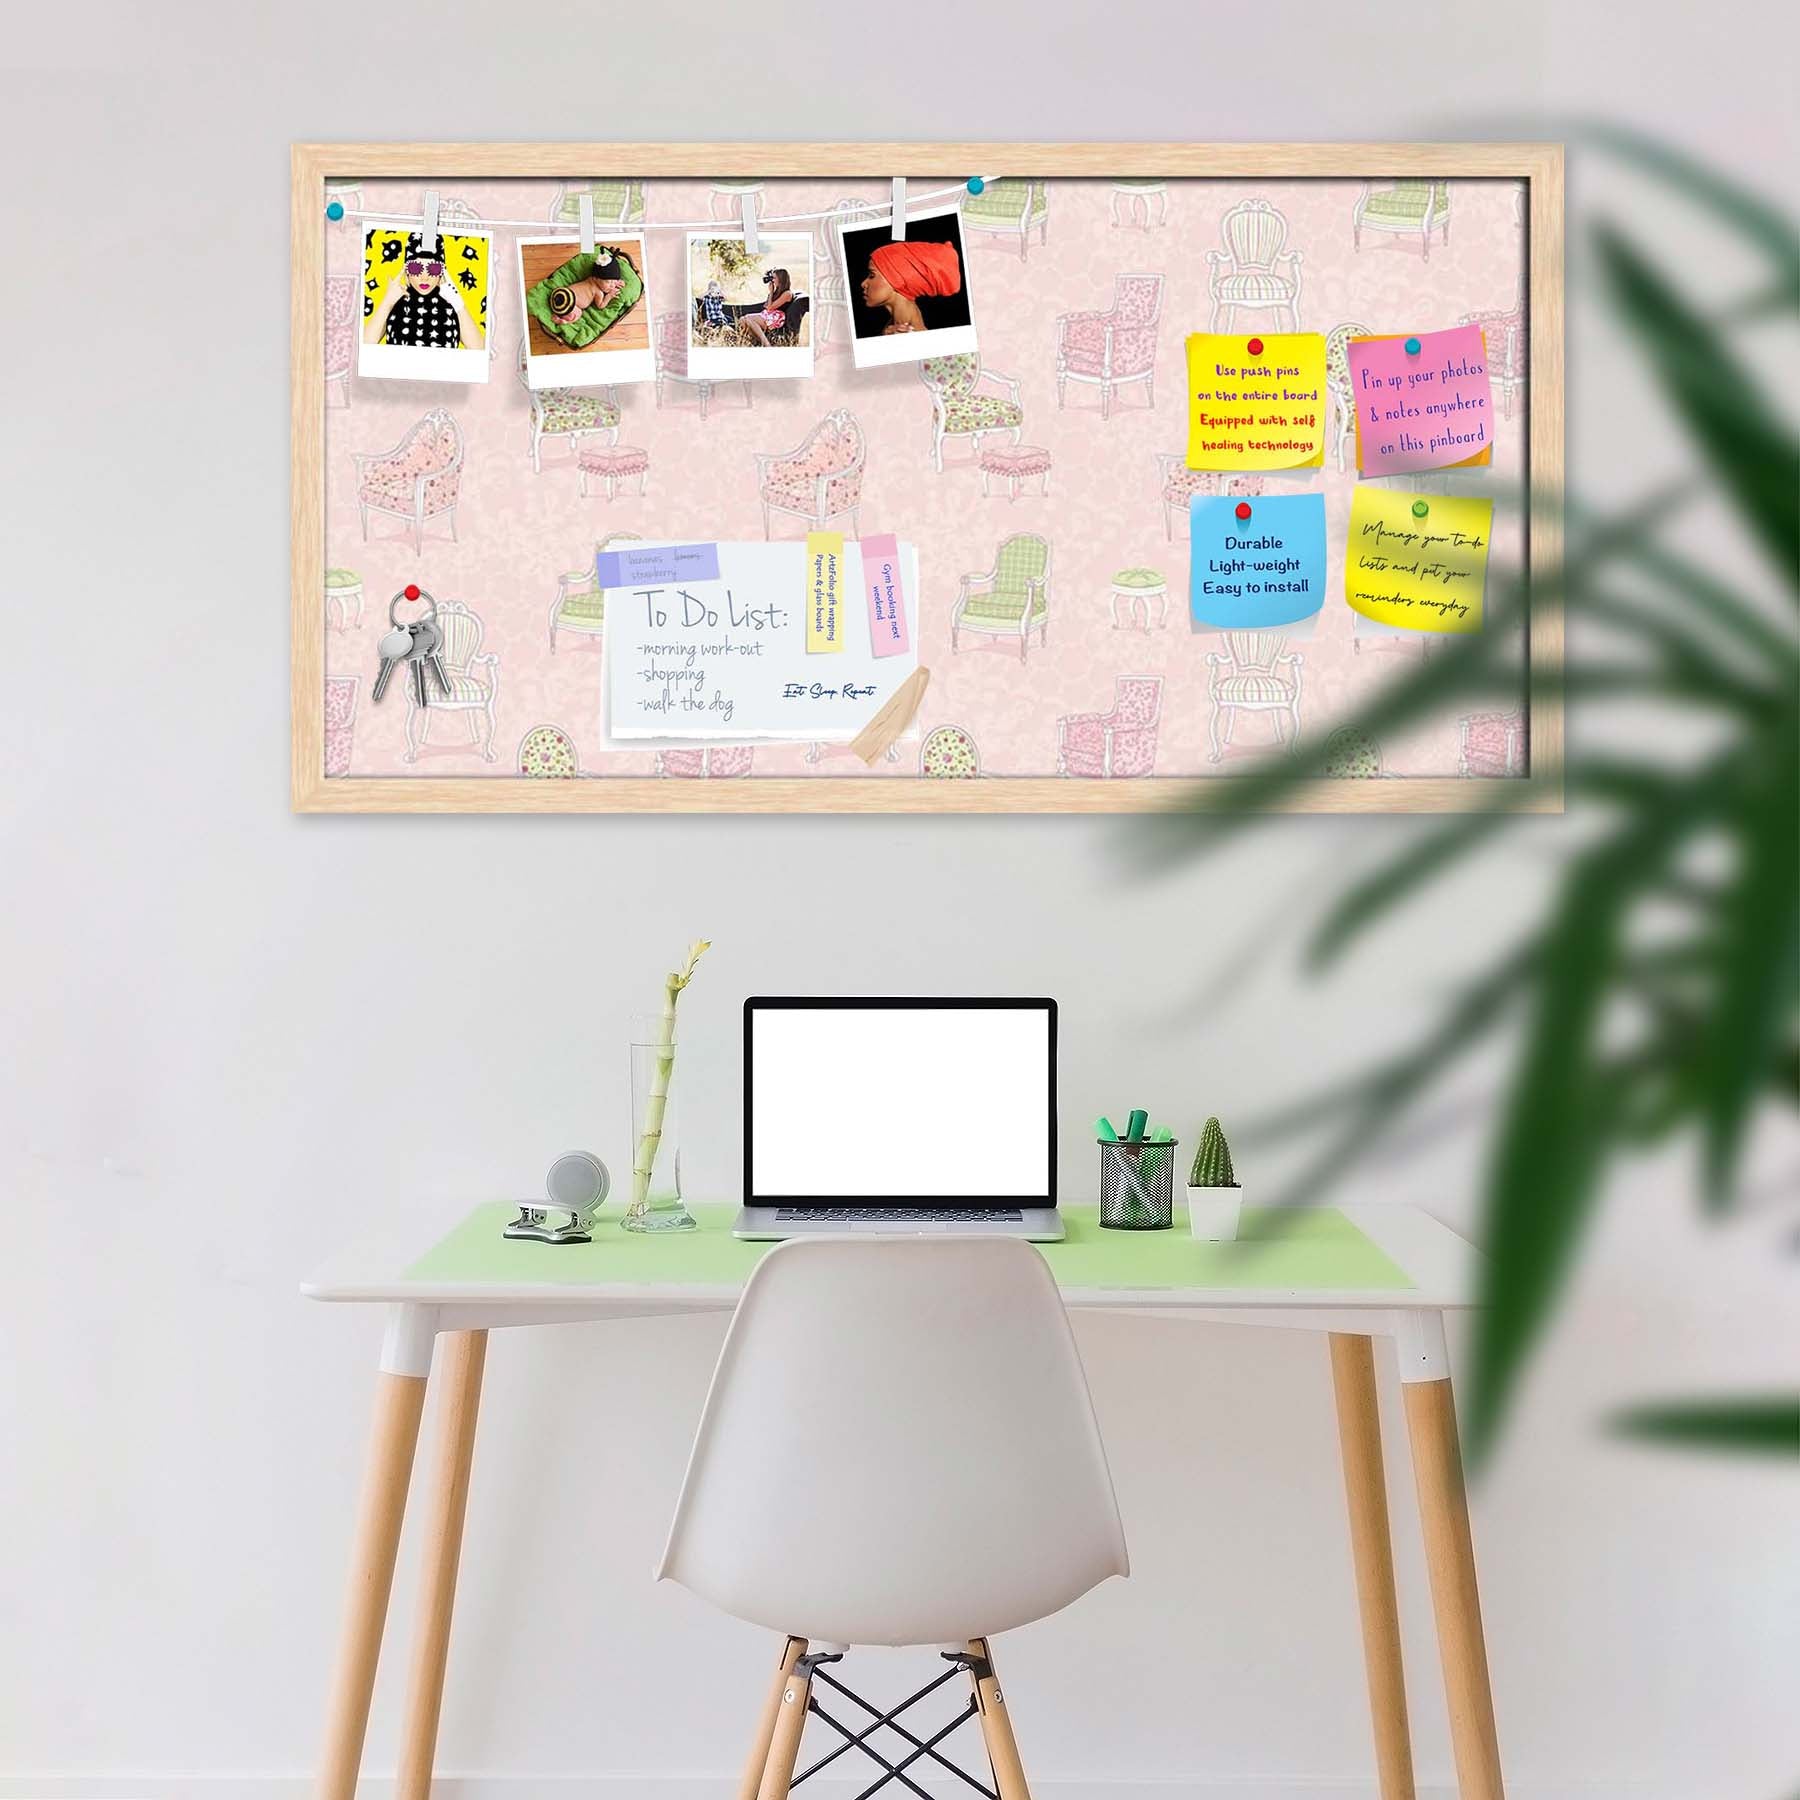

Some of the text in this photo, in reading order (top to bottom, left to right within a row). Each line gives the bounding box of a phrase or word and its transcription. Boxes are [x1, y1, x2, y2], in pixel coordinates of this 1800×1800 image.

[1216, 364, 1299, 380] Use push pins
[1362, 358, 1483, 390] Pin up your photos
[1198, 389, 1318, 401] on the entire board
[1370, 392, 1485, 422] & notes anywhere
[1200, 413, 1315, 429] Equipped with self
[1202, 440, 1313, 452] healing technology
[1381, 423, 1485, 455] on this pinboard
[1225, 536, 1283, 550] Durable
[1362, 520, 1420, 546] Manage
[1424, 535, 1449, 548] your
[814, 554, 824, 578] Papers
[1209, 558, 1301, 575] Light-weight
[1392, 562, 1419, 575] and
[1420, 563, 1447, 581] put
[1446, 569, 1472, 584] your
[814, 588, 825, 606] glass
[827, 553, 838, 641] ArtzFolio gift wrapping
[1203, 579, 1309, 597] Easy to install
[633, 590, 788, 630] To Do List:
[873, 585, 886, 620] weekend
[882, 563, 901, 639] Gym booking next
[1355, 592, 1470, 618] reminders everyday
[816, 607, 825, 632] boards
[701, 634, 764, 656] work-out
[782, 683, 808, 698] Eat
[842, 682, 877, 700] Repeat
[680, 688, 705, 711] the
[709, 690, 734, 721] dog
